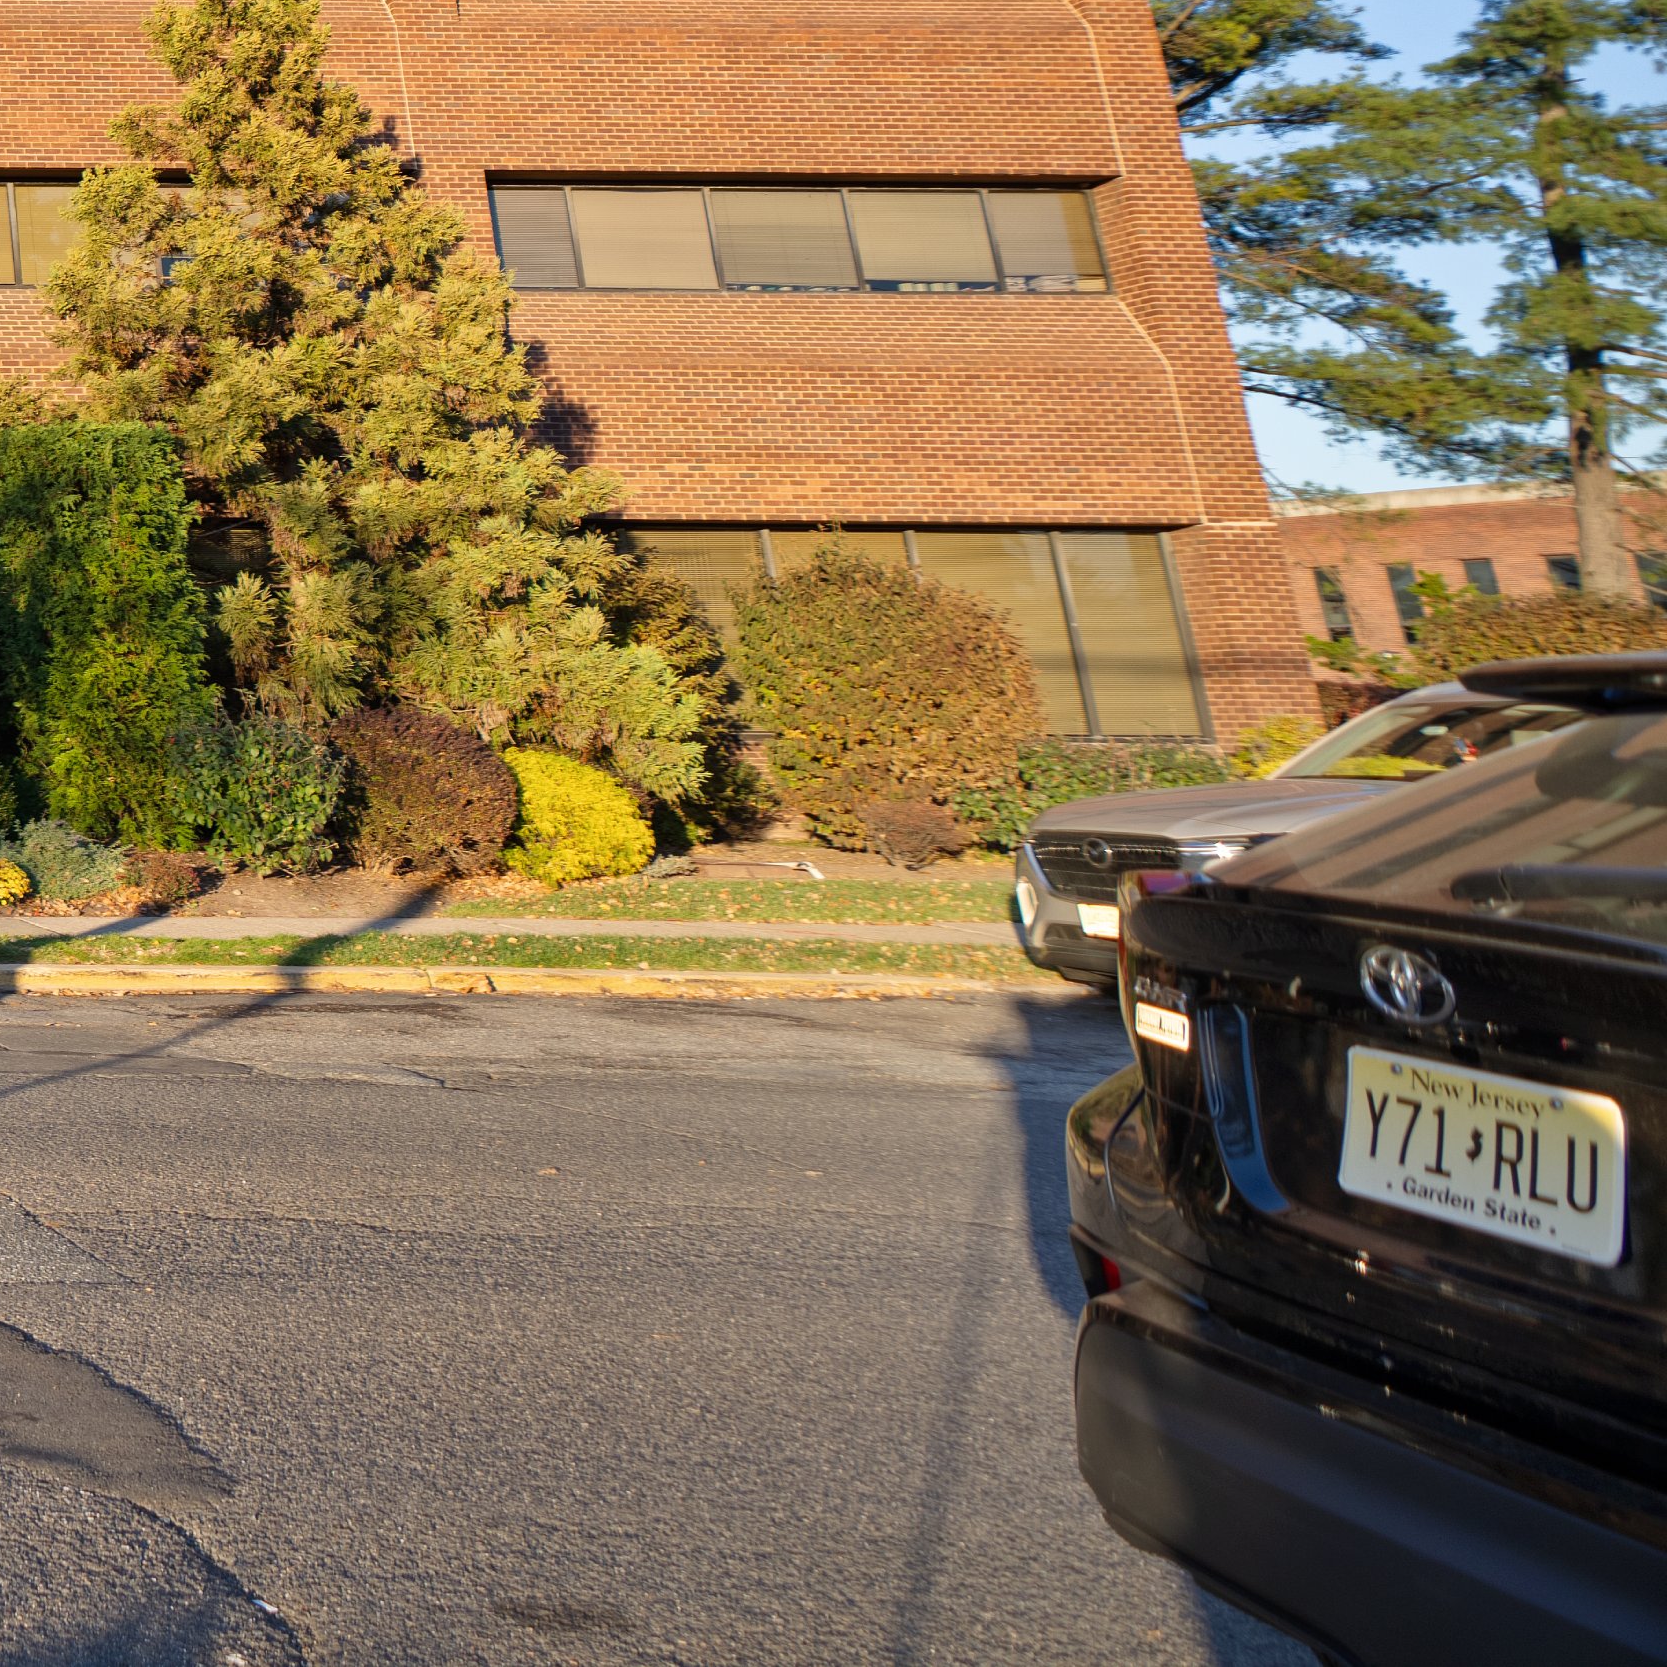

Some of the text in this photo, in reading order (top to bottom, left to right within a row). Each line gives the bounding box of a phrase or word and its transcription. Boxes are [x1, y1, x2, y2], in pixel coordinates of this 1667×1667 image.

[1409, 1068, 1544, 1120] New Jersey
[1365, 1087, 1599, 1214] Y71 RLU
[1402, 1175, 1542, 1231] Garden State
